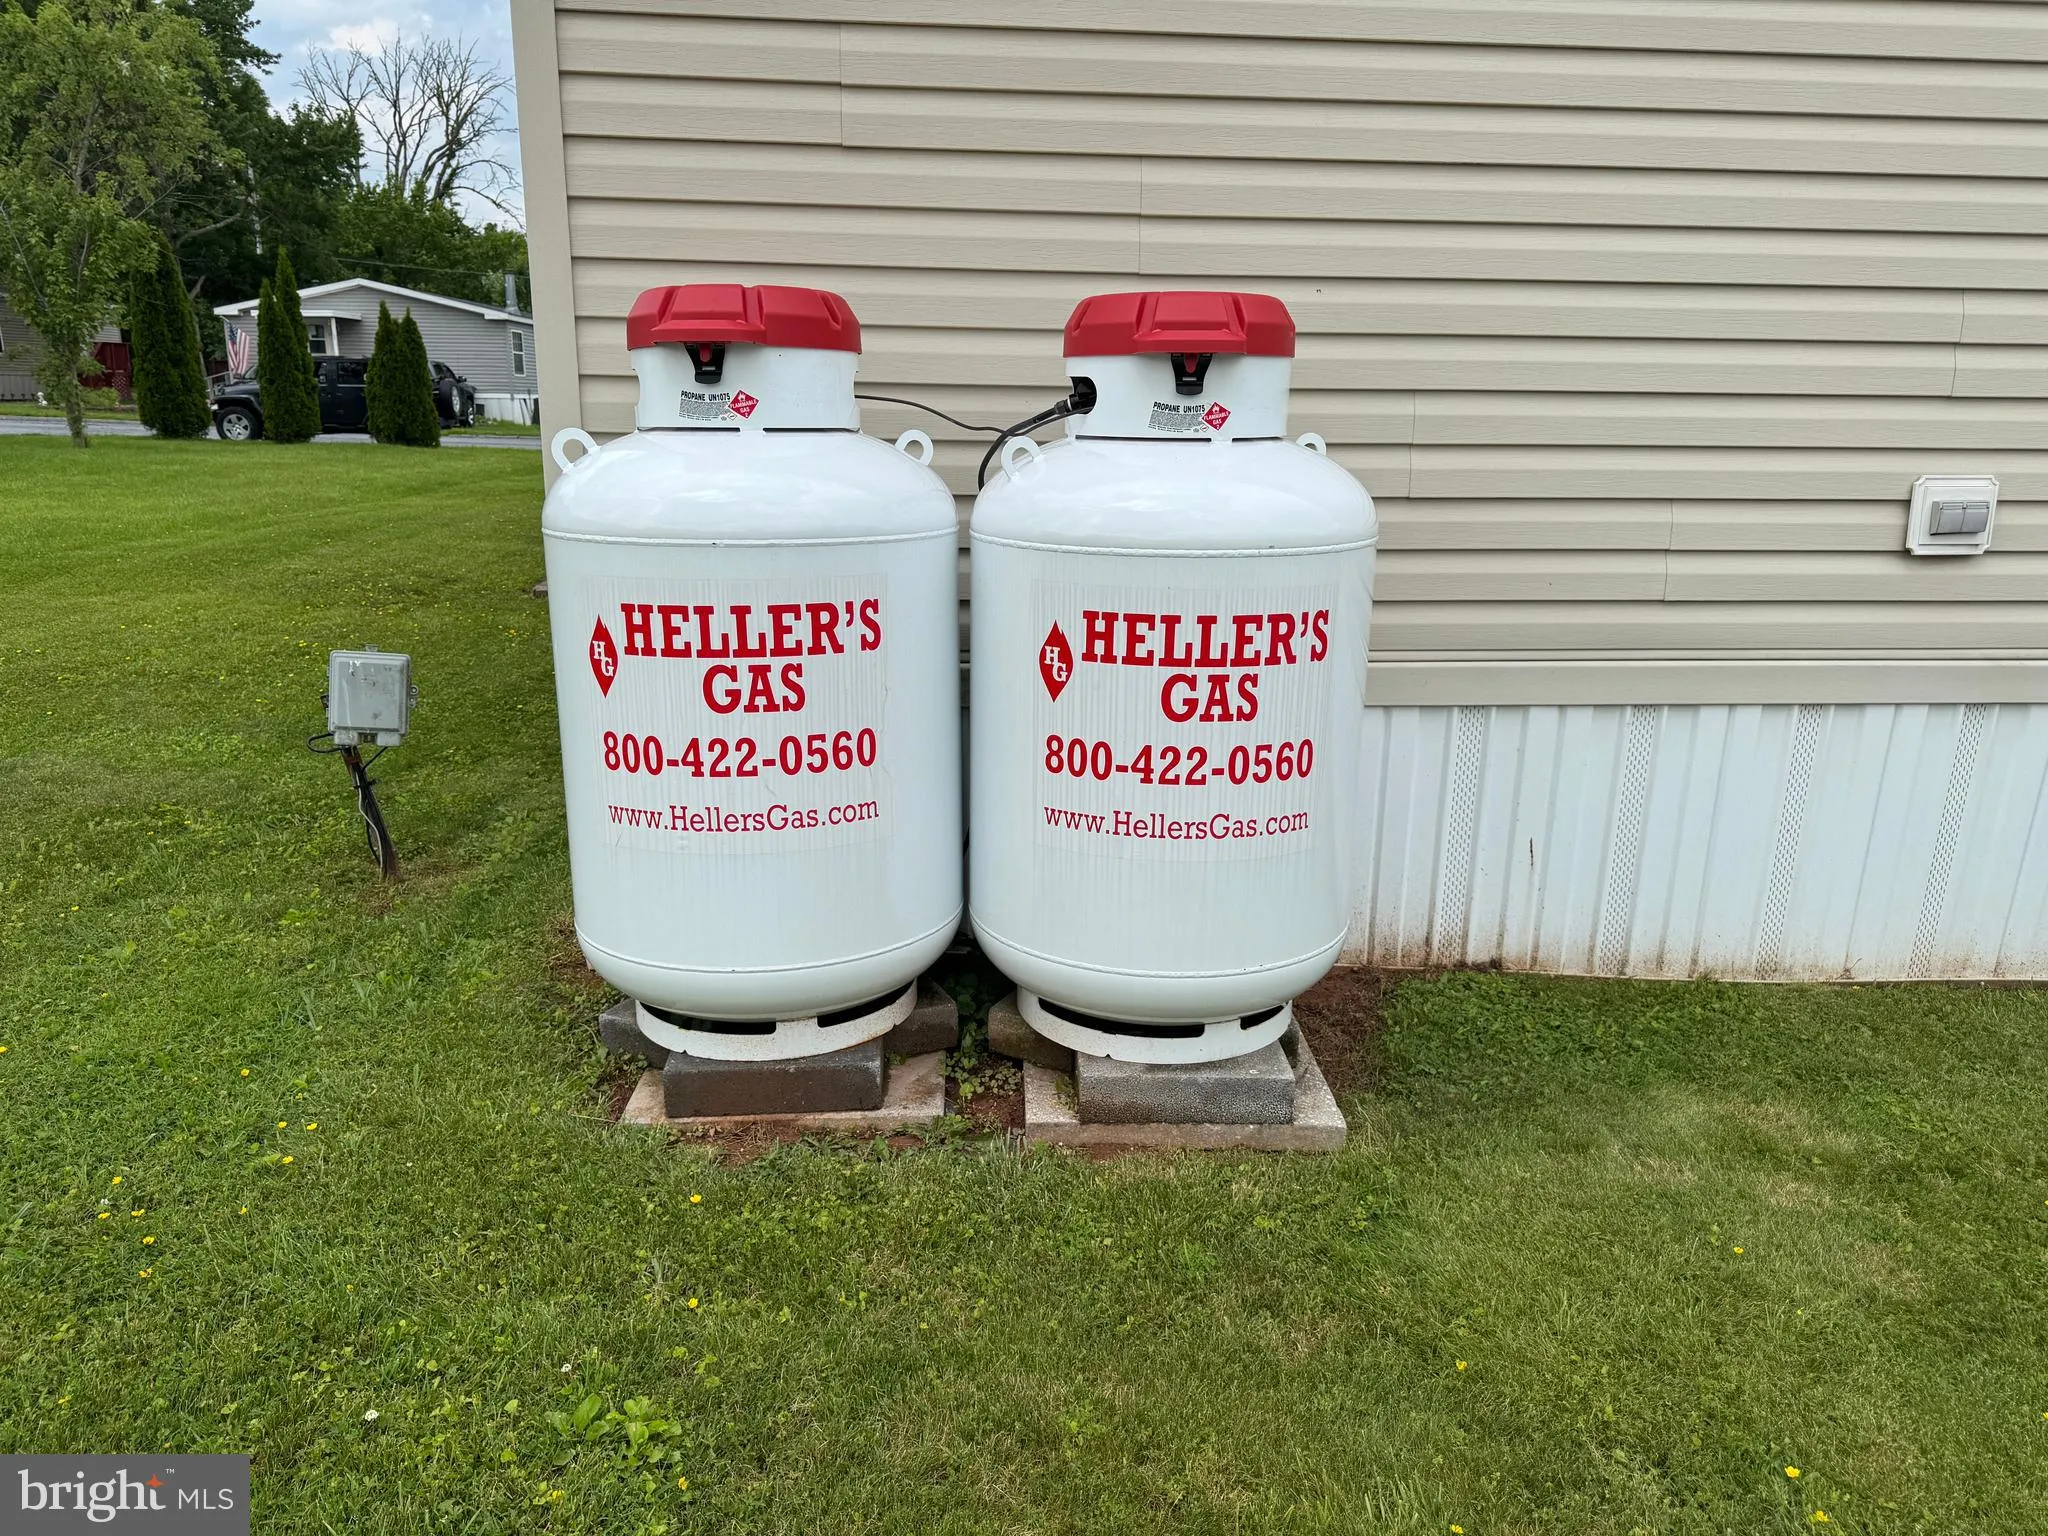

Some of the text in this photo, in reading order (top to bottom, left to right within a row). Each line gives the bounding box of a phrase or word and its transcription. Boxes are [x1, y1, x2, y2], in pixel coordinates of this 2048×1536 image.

[681, 390, 731, 401] PROPANE UN1075
[730, 399, 757, 409] FLAMMABLE
[1153, 401, 1205, 413] PROPANE UN1075
[1203, 411, 1229, 421] FLAMMABLE
[620, 598, 882, 659] HELLER'S
[1081, 609, 1329, 668] HELLER'S
[702, 662, 806, 714] GAS
[1160, 673, 1259, 723] GAS
[603, 727, 877, 778] 800-422-0560
[1045, 734, 1314, 786] 800-422-0560
[608, 800, 880, 833] www.HellersGas.com
[1044, 806, 1309, 840] www.HellersGas.com
